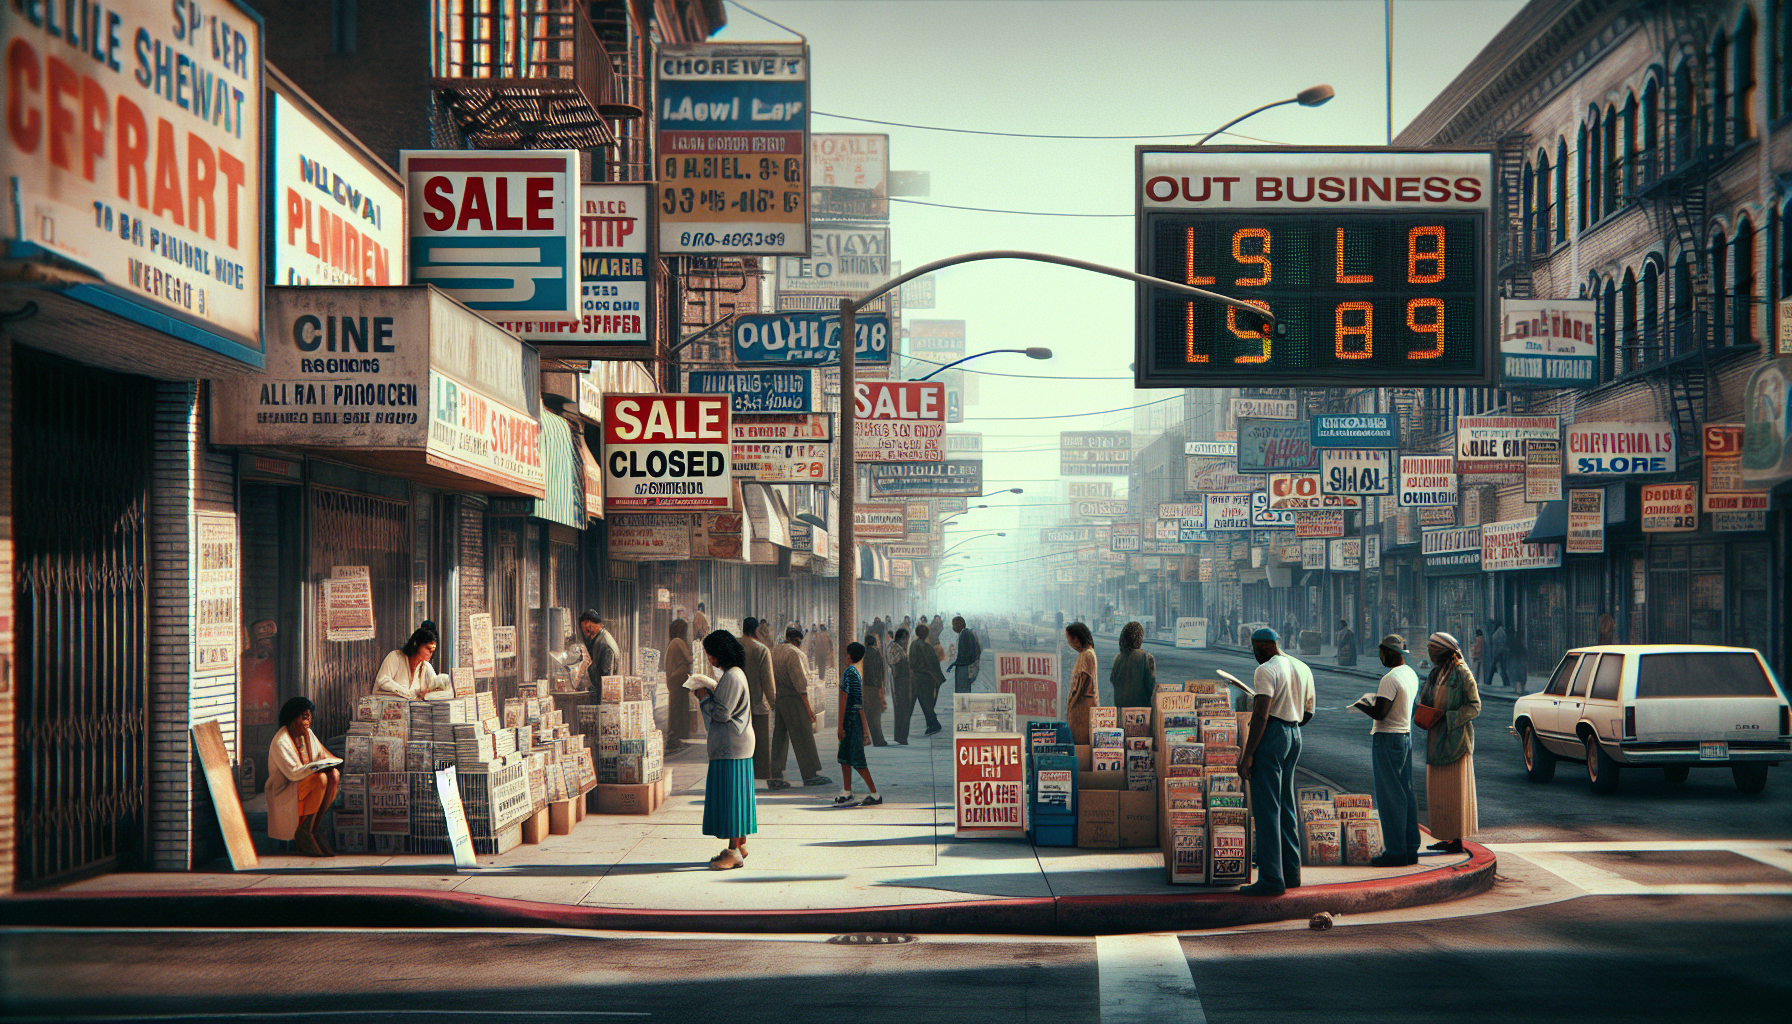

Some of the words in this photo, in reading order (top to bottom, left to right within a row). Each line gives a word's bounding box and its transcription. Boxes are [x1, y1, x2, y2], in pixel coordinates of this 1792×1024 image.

[423, 175, 555, 232] SALE
[1145, 175, 1241, 203] OUT
[1255, 176, 1483, 203] BUSINESS
[293, 314, 396, 353] CINE
[855, 383, 939, 419] SALE
[615, 400, 722, 440] SALE
[609, 449, 725, 479] CLOSED
